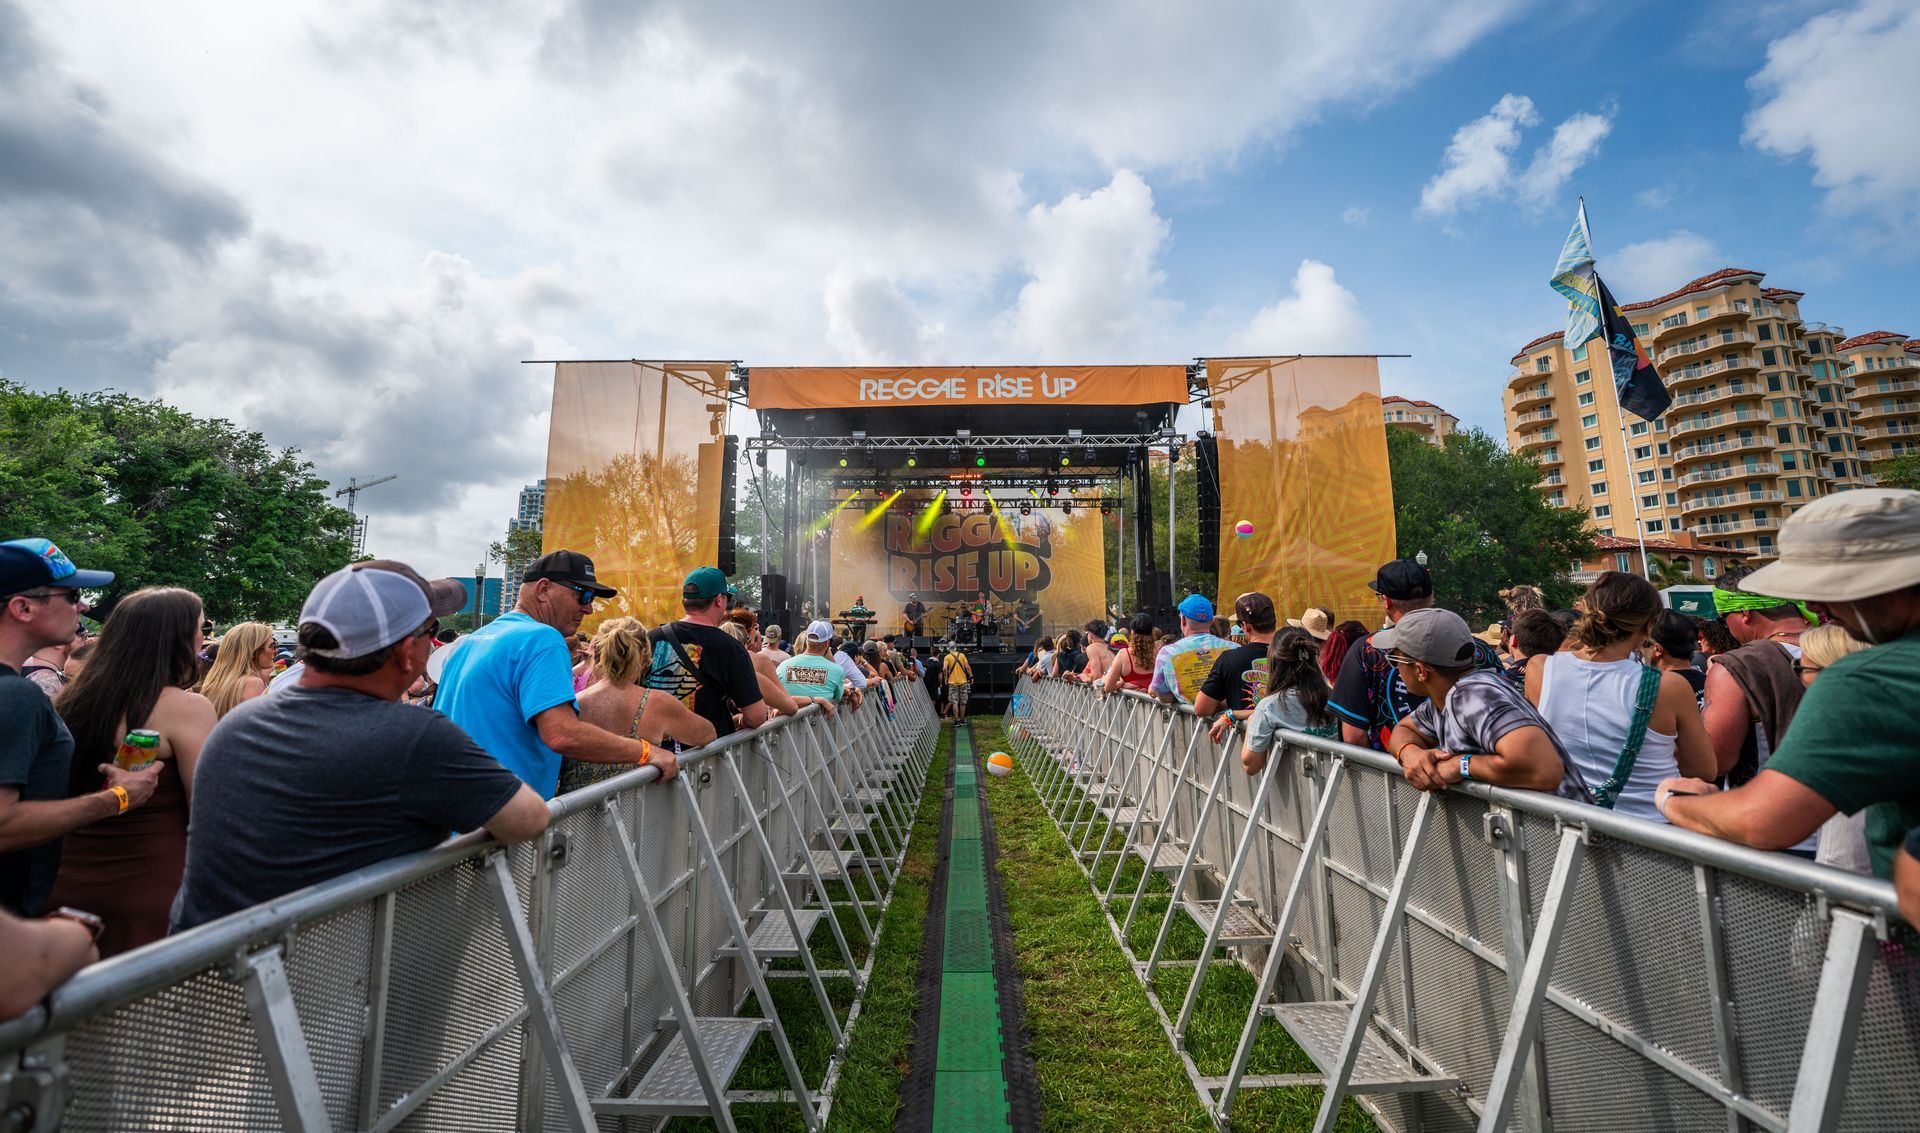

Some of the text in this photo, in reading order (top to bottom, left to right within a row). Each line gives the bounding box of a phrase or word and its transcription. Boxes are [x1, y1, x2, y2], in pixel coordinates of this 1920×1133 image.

[860, 372, 1077, 400] REGGAE RISE UP
[886, 513, 1041, 553] REGGAE
[890, 550, 1041, 592] RISE UP
